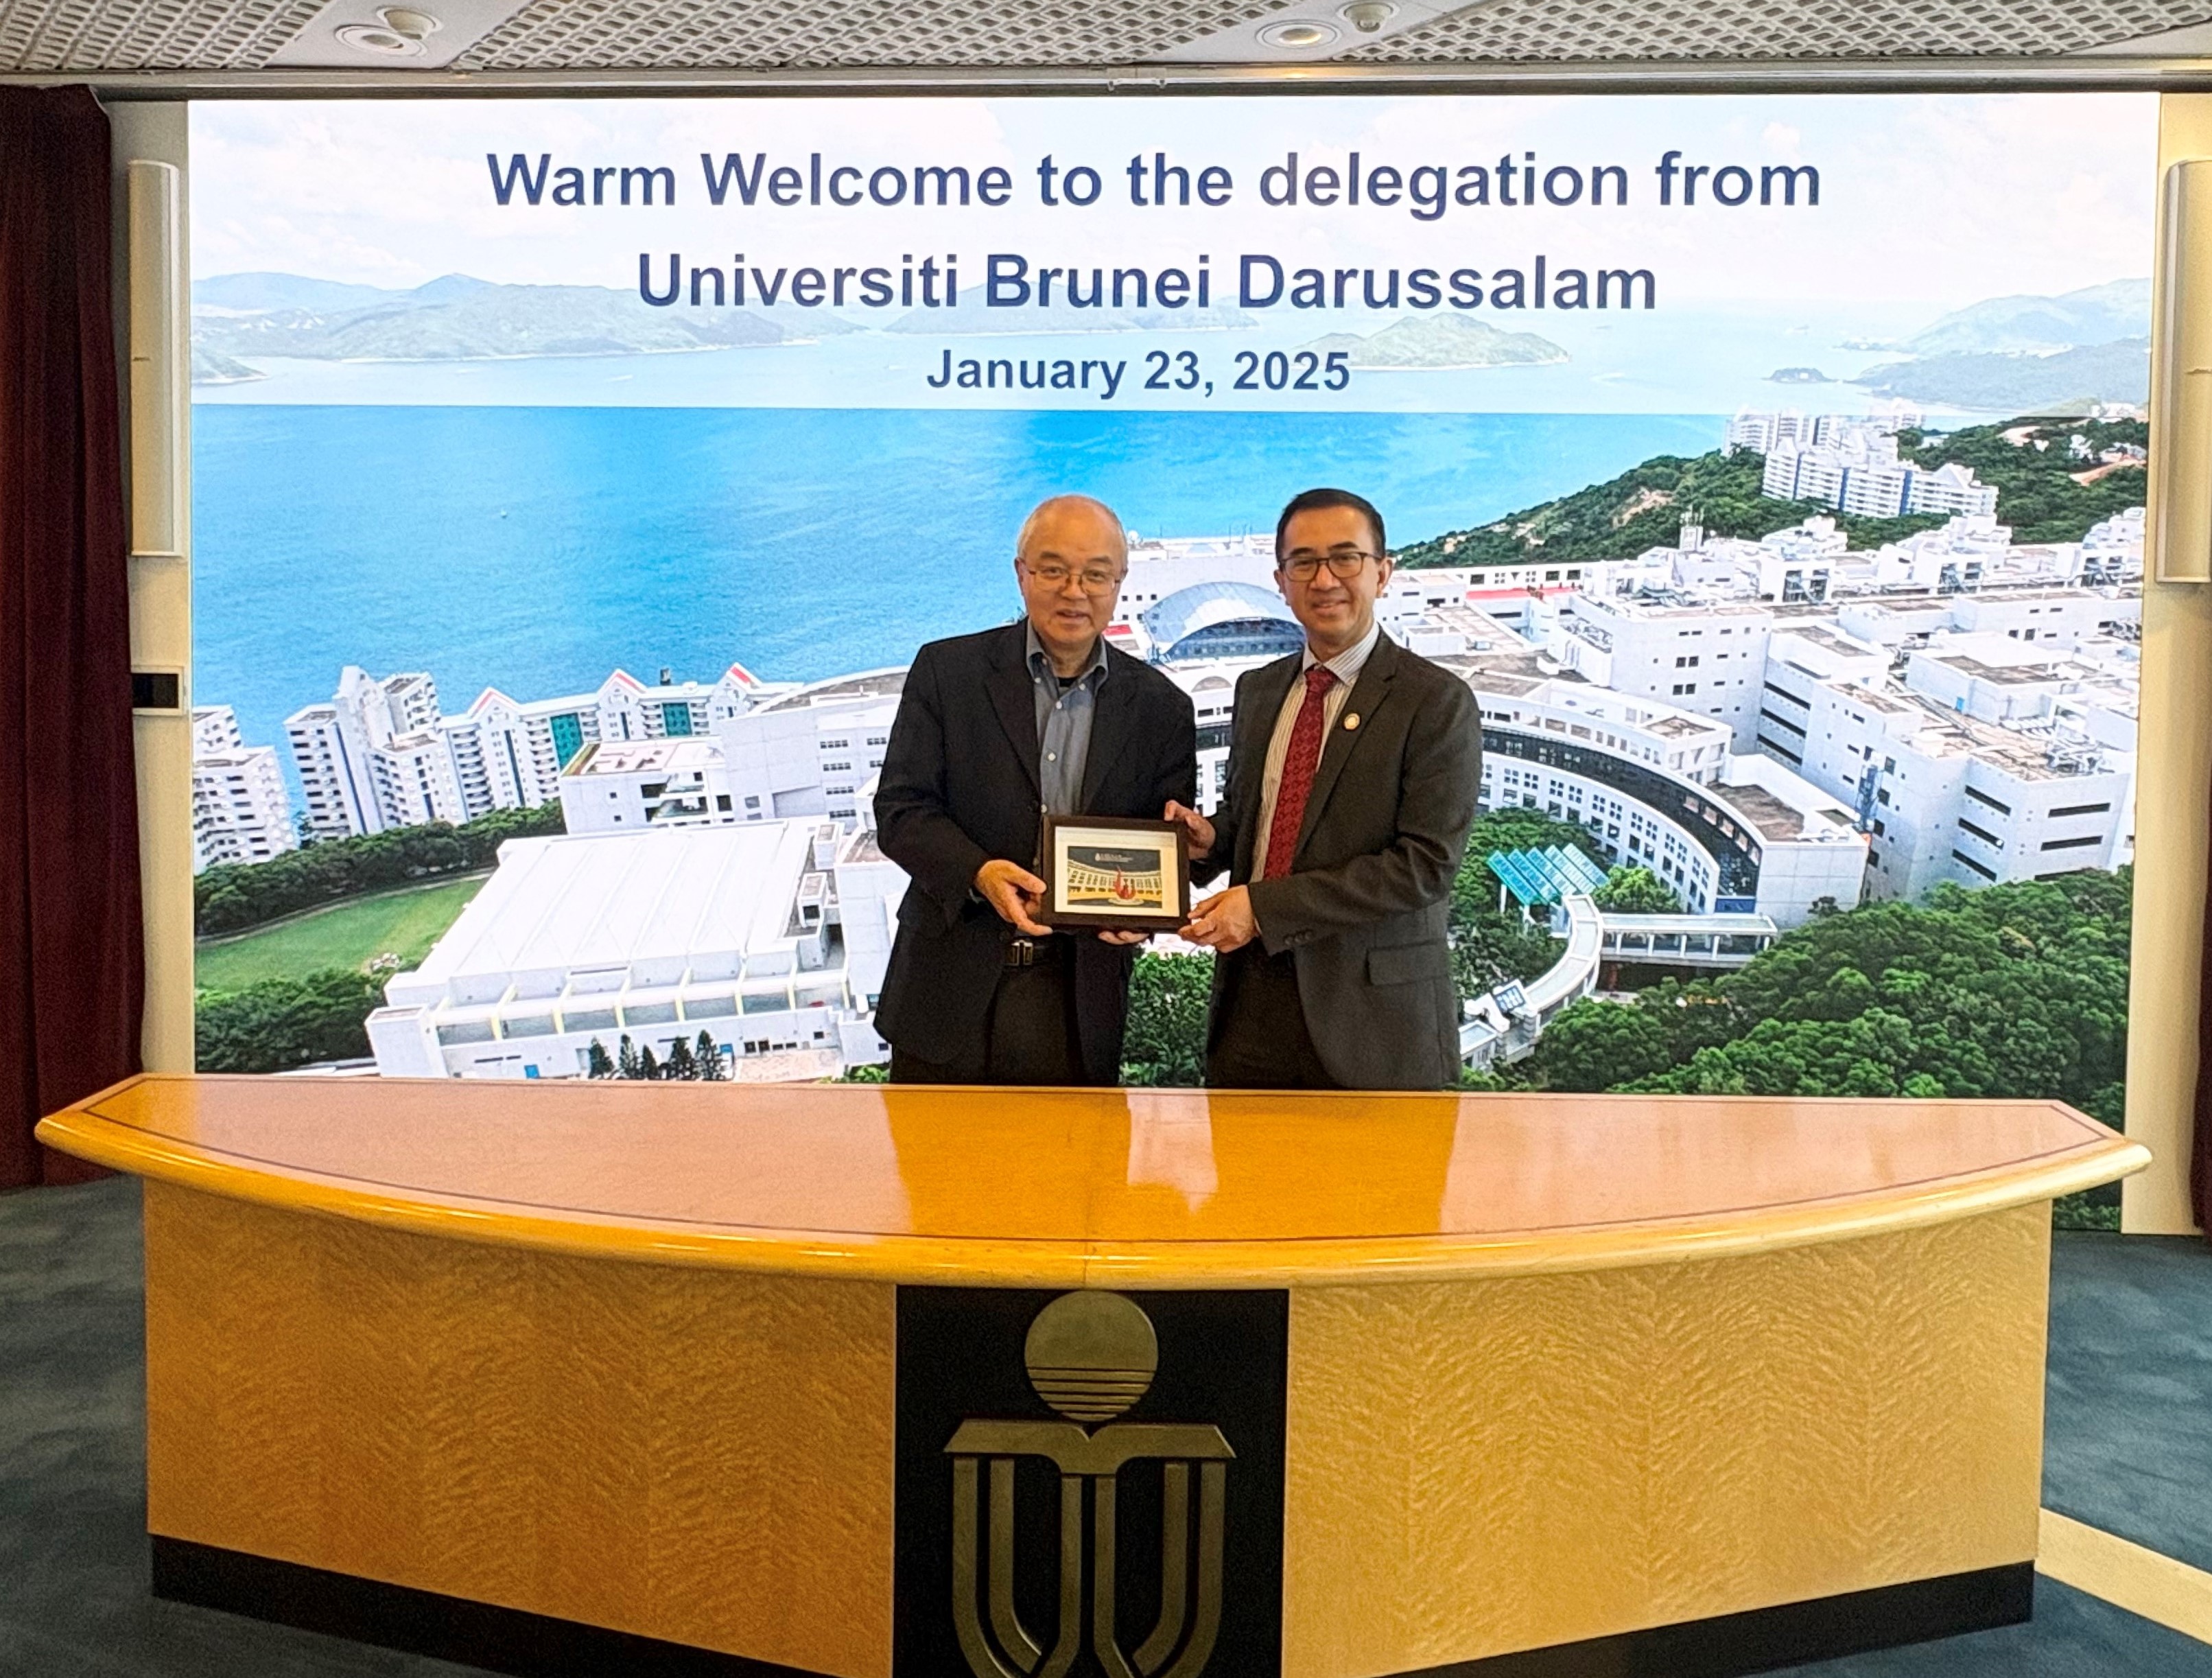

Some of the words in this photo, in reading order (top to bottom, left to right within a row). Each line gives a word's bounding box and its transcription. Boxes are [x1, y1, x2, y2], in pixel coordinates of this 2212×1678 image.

[487, 153, 674, 206] Warm
[701, 152, 1012, 206] Welcome
[1037, 154, 1101, 206] to
[1127, 152, 1232, 206] the
[1260, 152, 1627, 221] delegation
[1656, 150, 1819, 206] from
[639, 253, 956, 307] Universiti
[987, 254, 1209, 309] Brunei
[1239, 255, 1655, 310] Darussalam
[927, 349, 1127, 399] January
[1144, 350, 1213, 397] 23,
[1233, 351, 1350, 391] 2025
